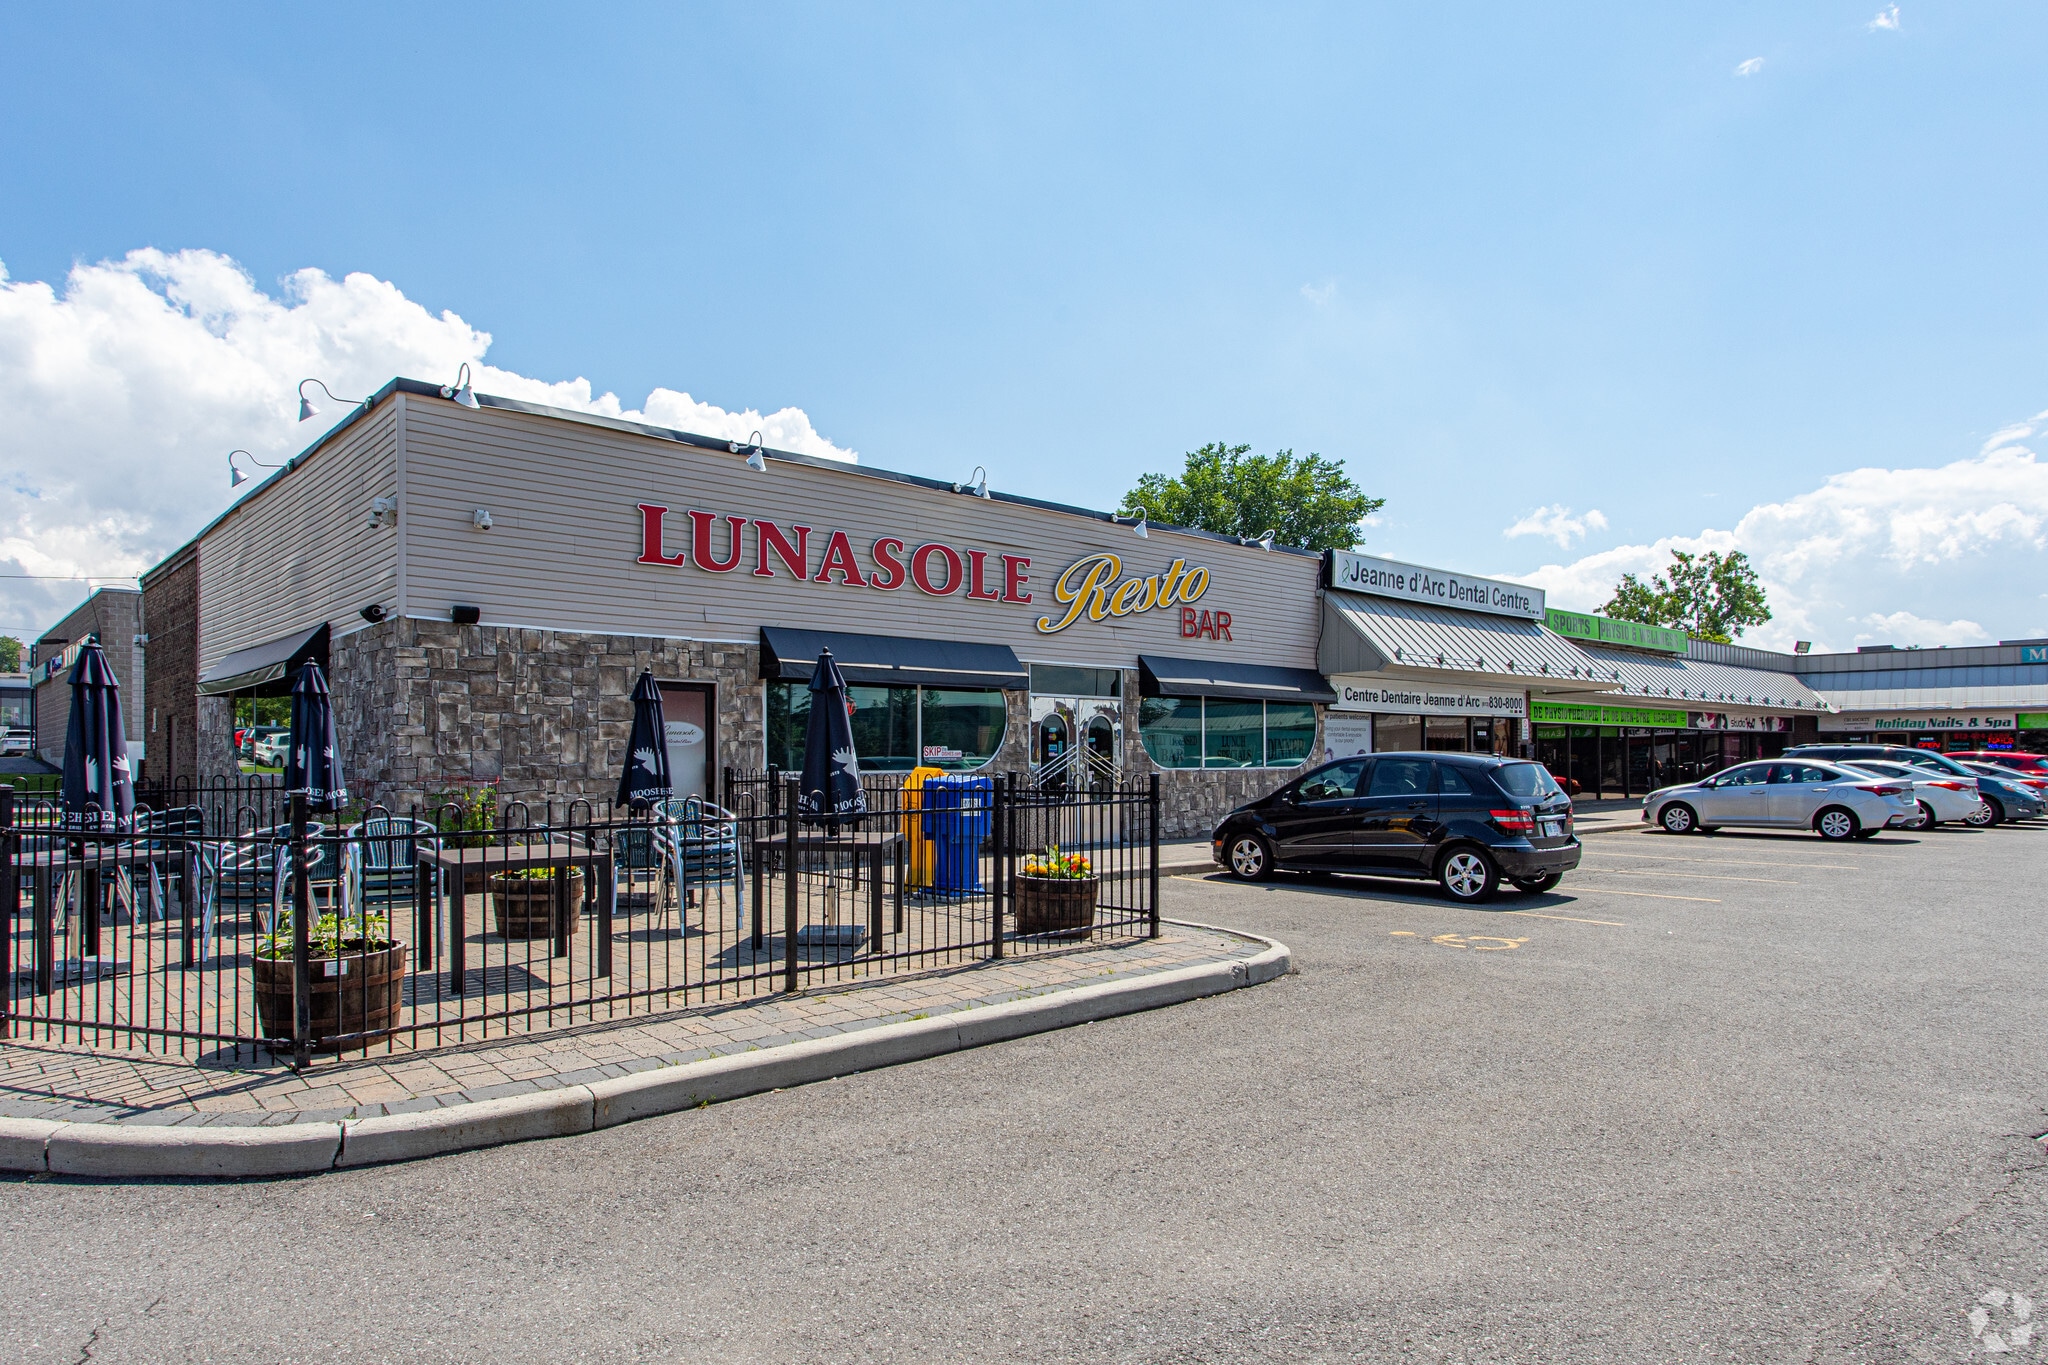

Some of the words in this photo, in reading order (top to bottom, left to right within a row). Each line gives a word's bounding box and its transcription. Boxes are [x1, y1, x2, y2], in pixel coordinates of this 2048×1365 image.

[637, 503, 1033, 605] LUNASOLE
[1036, 552, 1210, 634] Resto
[1350, 560, 1404, 590] Jeanne
[1409, 572, 1445, 598] d'Arc
[1449, 579, 1488, 605] Dental
[1492, 587, 1529, 611] Centre
[1181, 607, 1233, 641] BAR
[1553, 614, 1591, 635] SPORTS
[1600, 621, 1630, 641] PHYSIO
[1632, 627, 1637, 642] &
[1639, 628, 1679, 648] WELLNESS
[1344, 686, 1379, 702] Centre
[1381, 689, 1421, 704] Dentaire
[1423, 692, 1455, 706] Jeanne
[1457, 694, 1480, 708] d'Arc
[1489, 696, 1523, 709] 830-8000
[1533, 706, 1543, 718] DE
[1544, 704, 1599, 721] PHYSIOTHÉRAPIE
[1602, 710, 1610, 721] ET
[1612, 711, 1619, 722] DE
[1620, 709, 1650, 723] BIEN-ÊTRE
[1875, 717, 1926, 728] Holiday
[1928, 716, 1963, 728] Nails
[1968, 717, 1979, 728] &
[1985, 717, 2012, 729] Spa
[1221, 735, 1246, 747] LUNCH
[1917, 741, 1941, 749] OPEN
[924, 746, 941, 757] SKIP
[1161, 749, 1185, 762] BAR
